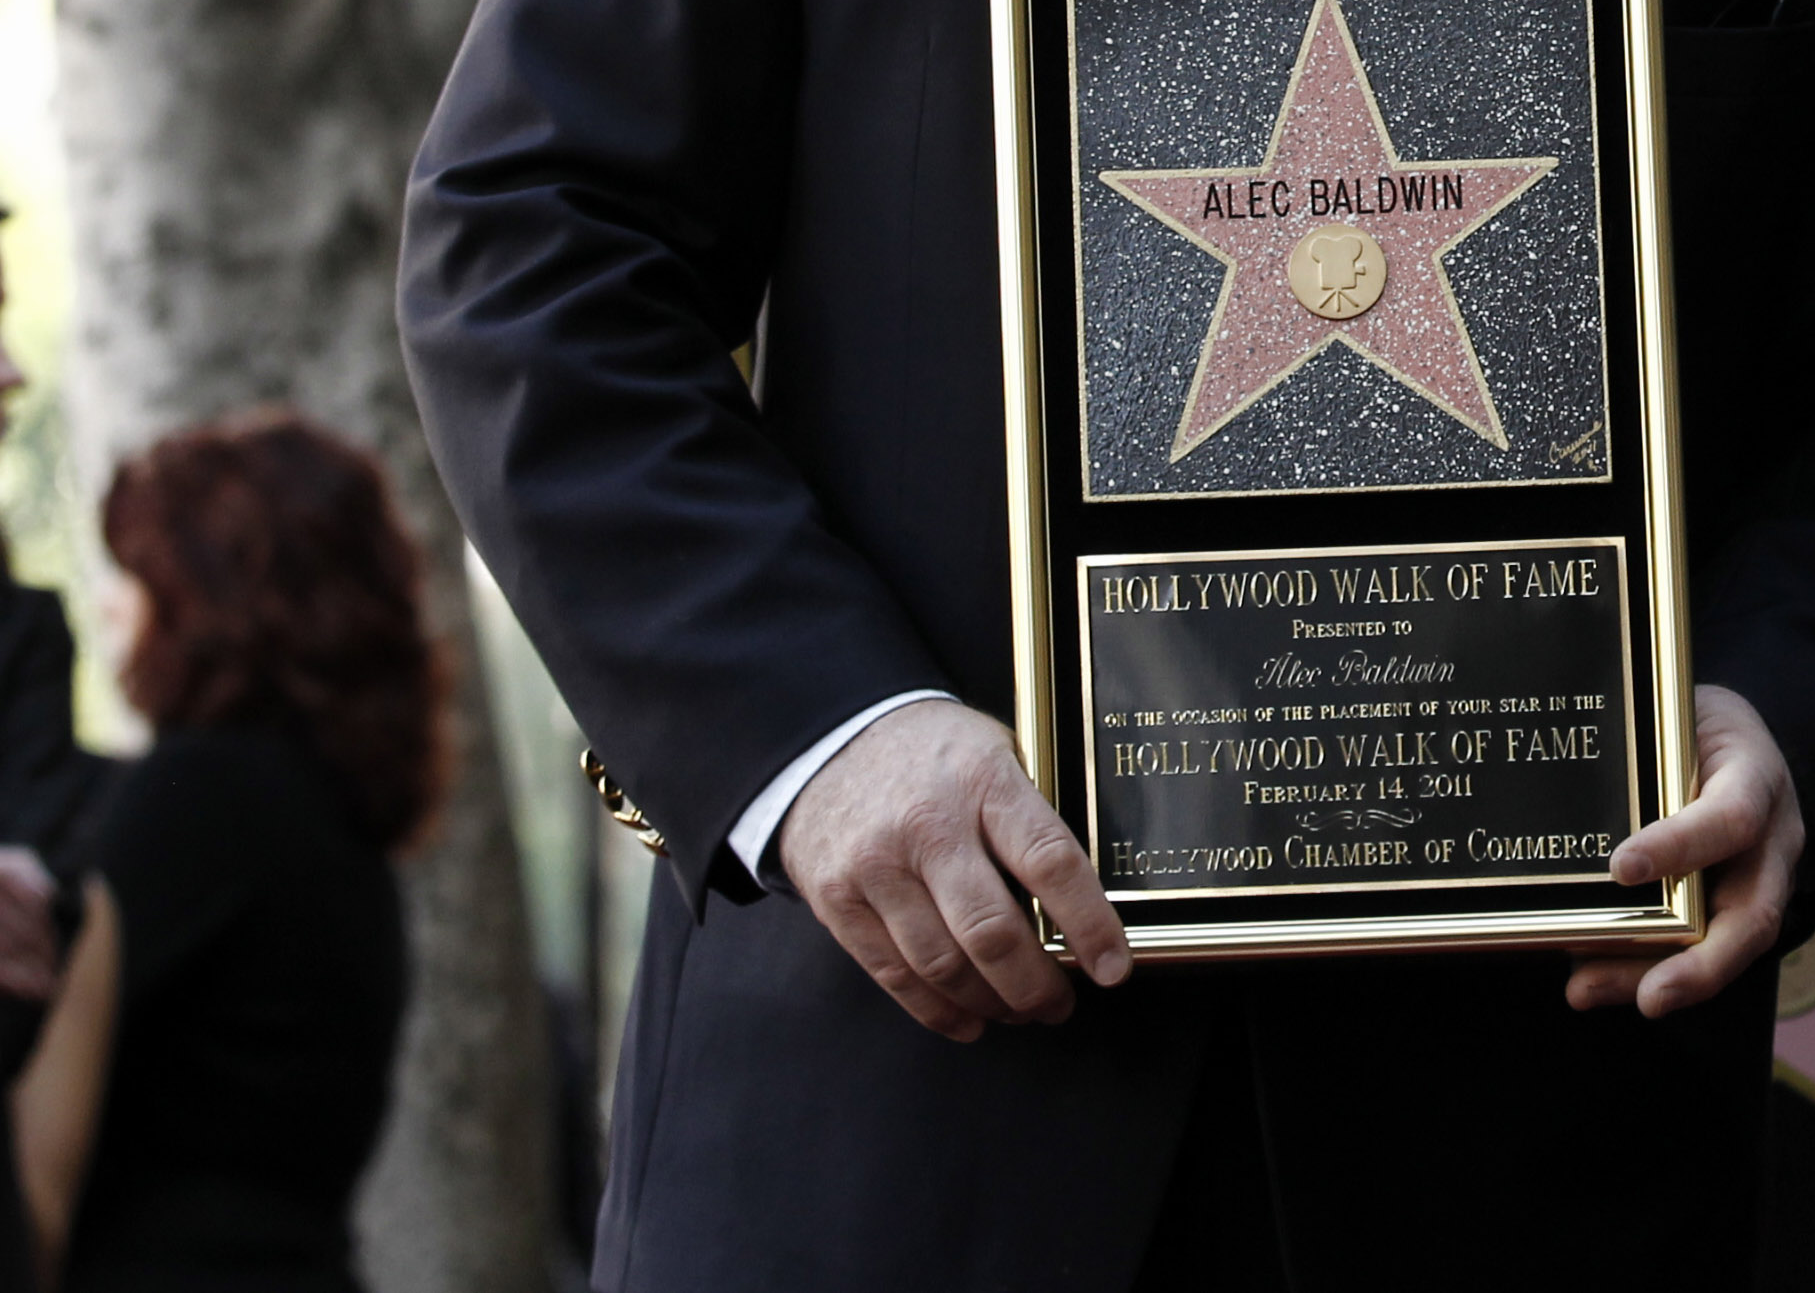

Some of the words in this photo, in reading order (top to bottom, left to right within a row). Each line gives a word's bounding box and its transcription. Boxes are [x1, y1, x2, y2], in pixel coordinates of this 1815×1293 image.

[1203, 180, 1291, 220] ALEC
[1311, 174, 1463, 215] BALDWIN
[1103, 570, 1318, 614] HOLLYWOOD
[1330, 565, 1434, 604] WALK
[1447, 564, 1488, 600] OF
[1503, 558, 1600, 599] FAME
[1255, 652, 1322, 689] Alec
[1332, 650, 1456, 686] Baldwin
[1104, 713, 1128, 728] ON
[1135, 711, 1166, 726] THE
[1172, 708, 1248, 724] OCCASION
[1254, 707, 1275, 721] OF
[1282, 705, 1313, 721] THE
[1321, 702, 1411, 719] PLACEMENT
[1419, 701, 1439, 716] OF
[1446, 700, 1492, 715] YOUR
[1499, 696, 1541, 712] STAR
[1549, 696, 1566, 710] IN
[1574, 695, 1605, 710] THE
[1113, 736, 1325, 777] HOLLYWOOD
[1336, 733, 1439, 767] WALK
[1451, 730, 1491, 763] OF
[1506, 726, 1600, 762] FAME
[1419, 775, 1473, 798] 2011
[1112, 842, 1273, 876] HOLLYWOOD
[1426, 840, 1455, 863] OF
